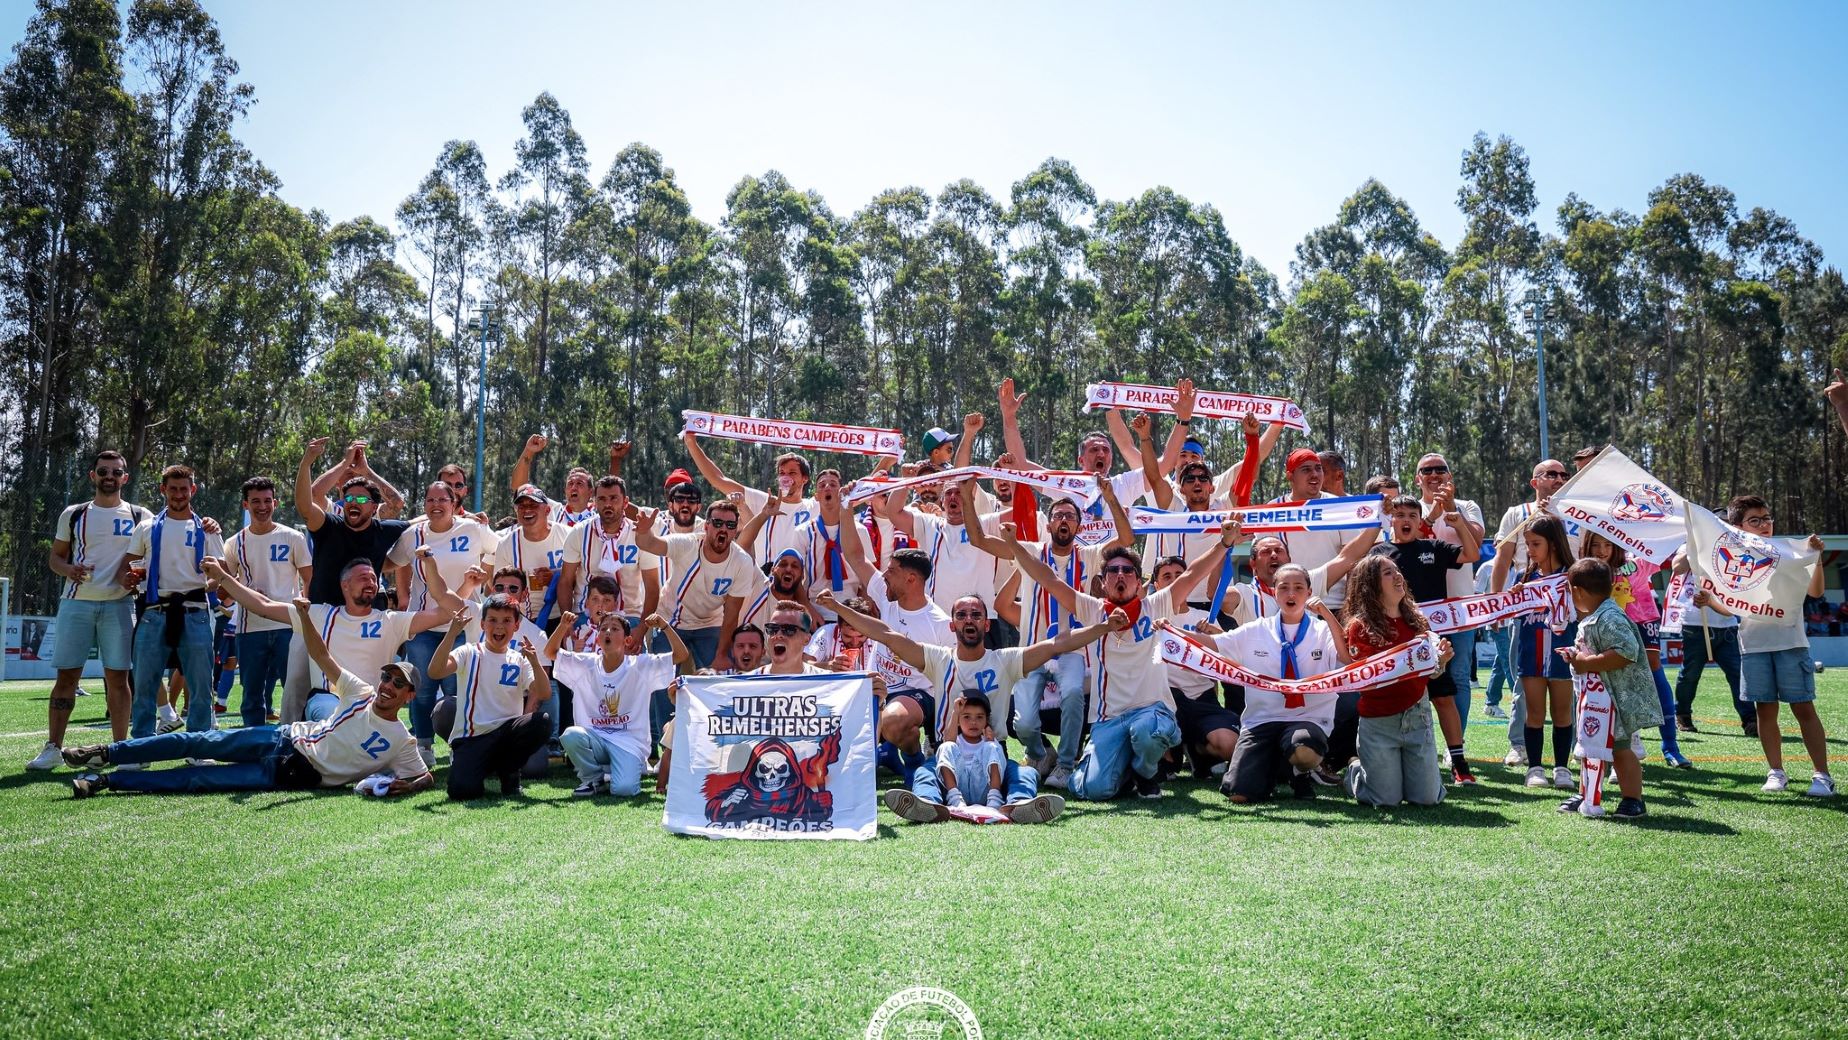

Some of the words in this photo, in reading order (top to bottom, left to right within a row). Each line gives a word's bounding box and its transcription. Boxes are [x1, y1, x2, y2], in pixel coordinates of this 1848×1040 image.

[794, 428, 865, 446] CAMPEÕES
[113, 518, 134, 537] 12
[794, 510, 811, 526] 12
[1564, 520, 1580, 537] 2
[1565, 506, 1598, 524] ADC
[1598, 520, 1654, 557] Remelhe
[270, 544, 290, 562] 12
[450, 535, 470, 553] 12
[618, 545, 638, 564] 12
[711, 578, 733, 596] 12
[360, 620, 382, 638] 12
[1132, 615, 1153, 643] 12
[499, 663, 520, 687] 12
[975, 668, 999, 694] 12
[733, 695, 817, 717] ULTRAS
[708, 715, 842, 737] REMELHENSES
[360, 731, 391, 760] 12
